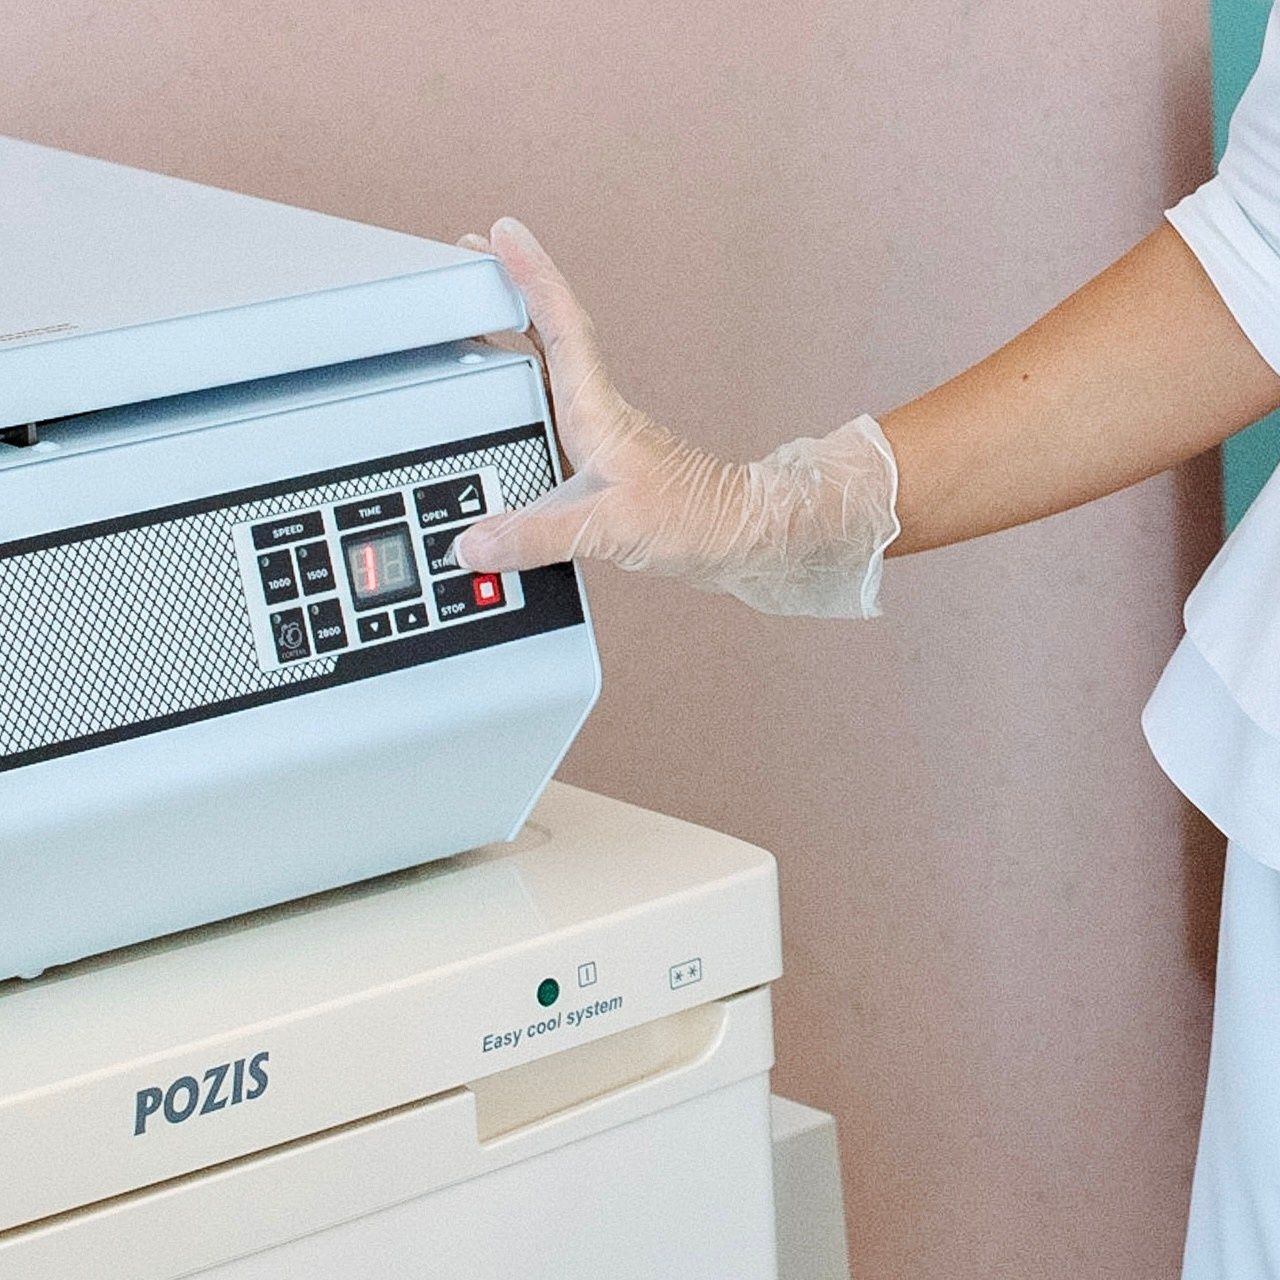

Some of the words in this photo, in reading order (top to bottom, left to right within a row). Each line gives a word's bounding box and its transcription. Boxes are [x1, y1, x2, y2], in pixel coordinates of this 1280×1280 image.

[358, 505, 383, 519] TIME
[421, 509, 449, 523] OPEN
[272, 523, 304, 540] SPEED
[306, 568, 329, 581] 1500
[268, 577, 292, 591] 1000
[440, 603, 466, 617] STOP
[482, 1029, 522, 1053] Easy
[527, 1012, 562, 1038] cool
[566, 996, 624, 1027] system
[133, 1051, 270, 1136] POZIS
